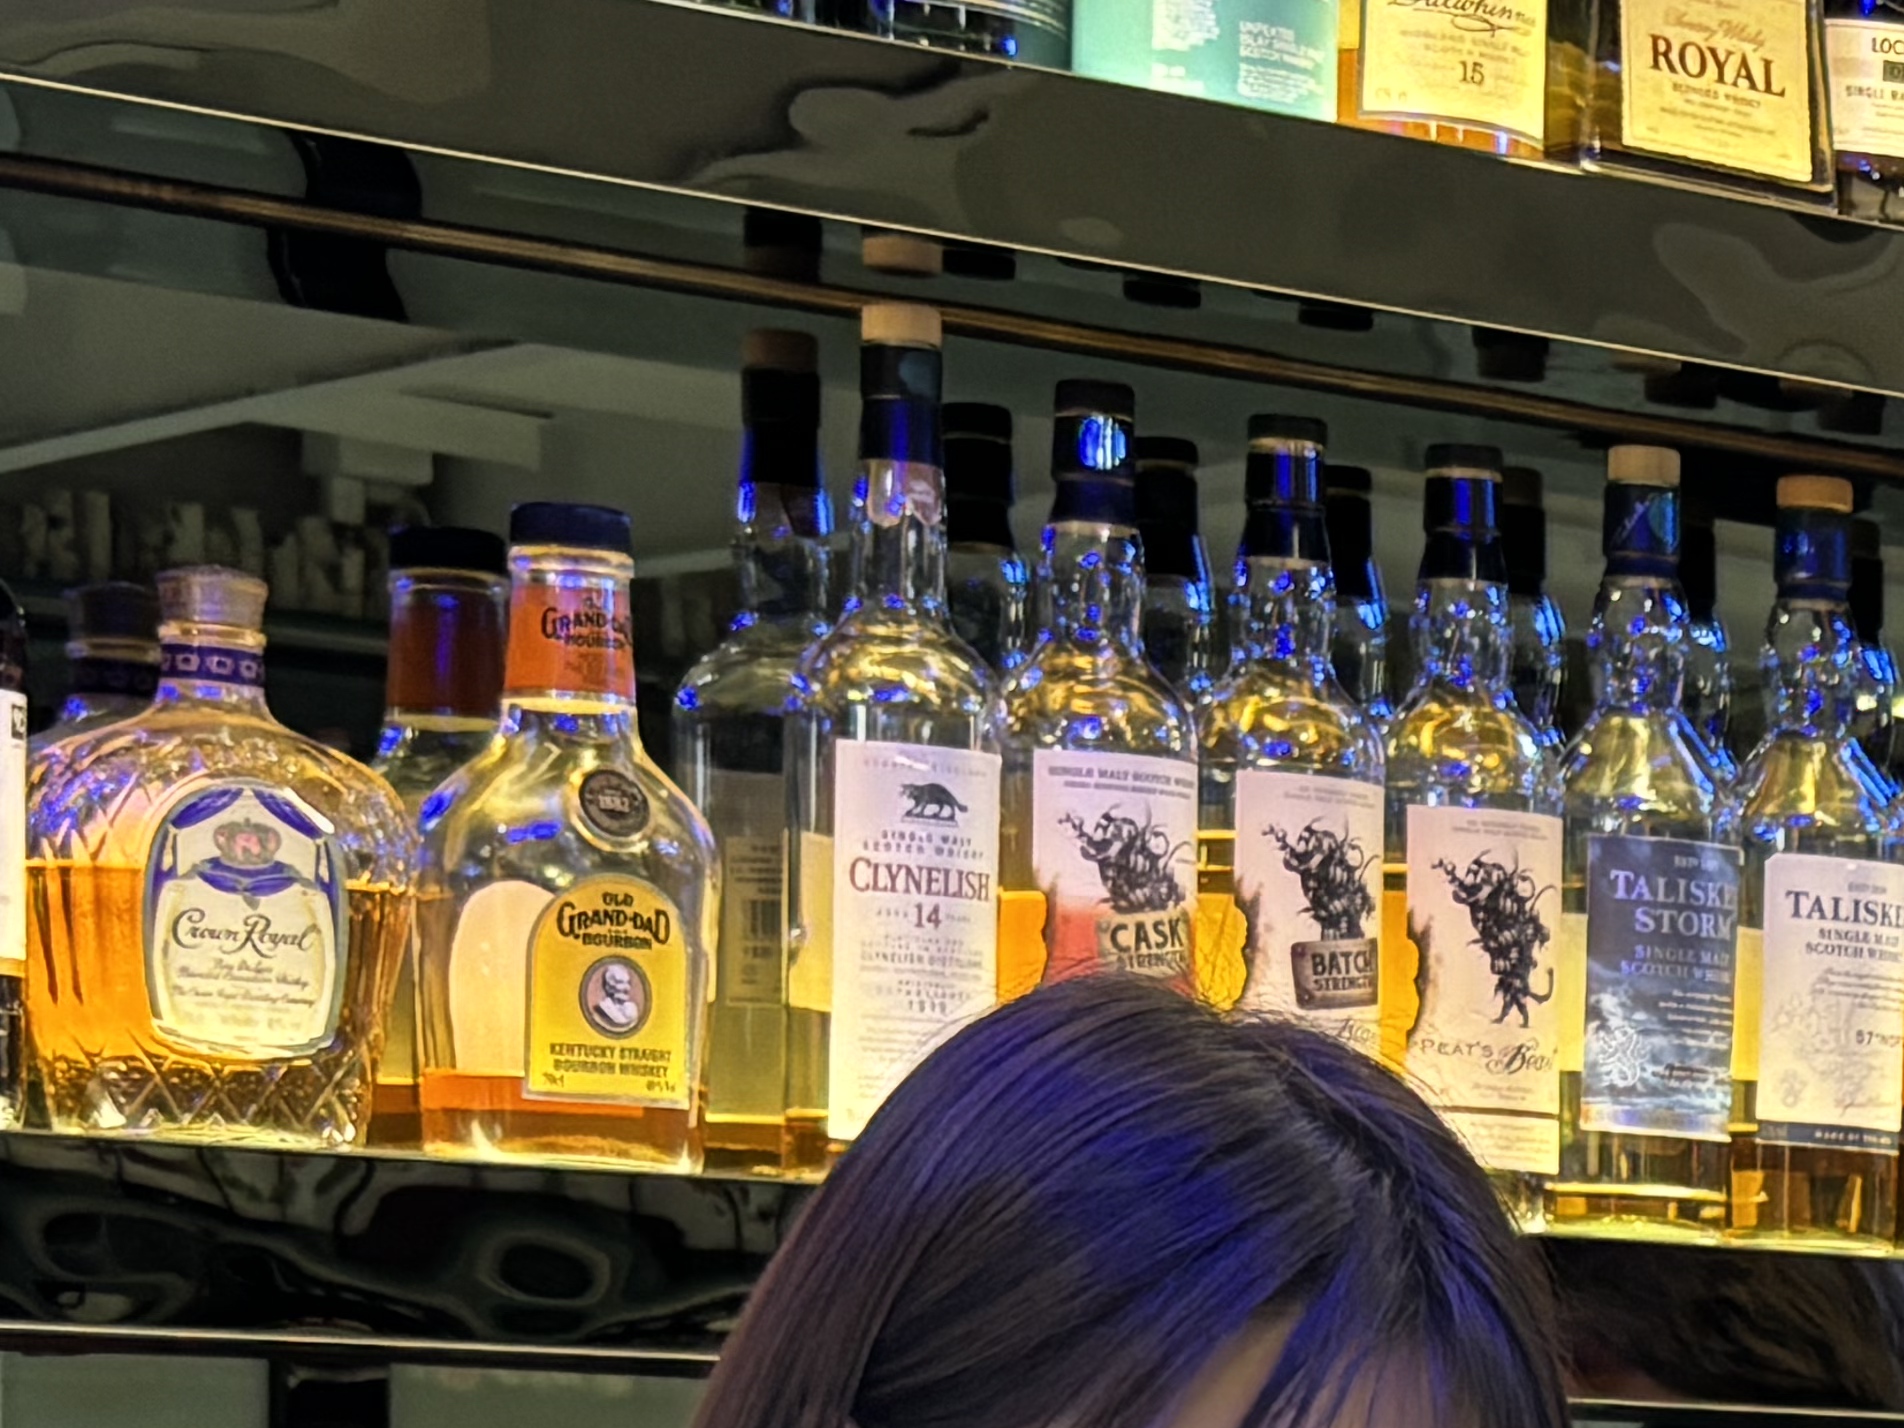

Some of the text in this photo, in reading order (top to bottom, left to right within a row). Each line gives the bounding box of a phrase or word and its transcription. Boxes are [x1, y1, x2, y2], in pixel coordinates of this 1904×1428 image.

[1459, 60, 1486, 86] 15
[1648, 33, 1787, 98] ROYAL
[849, 855, 990, 902] CLYNELISH
[602, 892, 634, 908] OLD
[912, 902, 942, 929] 14
[171, 907, 322, 959] Crown Royal
[556, 902, 671, 946] GRAND-DAD
[1109, 917, 1185, 951] CASK
[1419, 1038, 1492, 1060] PEAT'S
